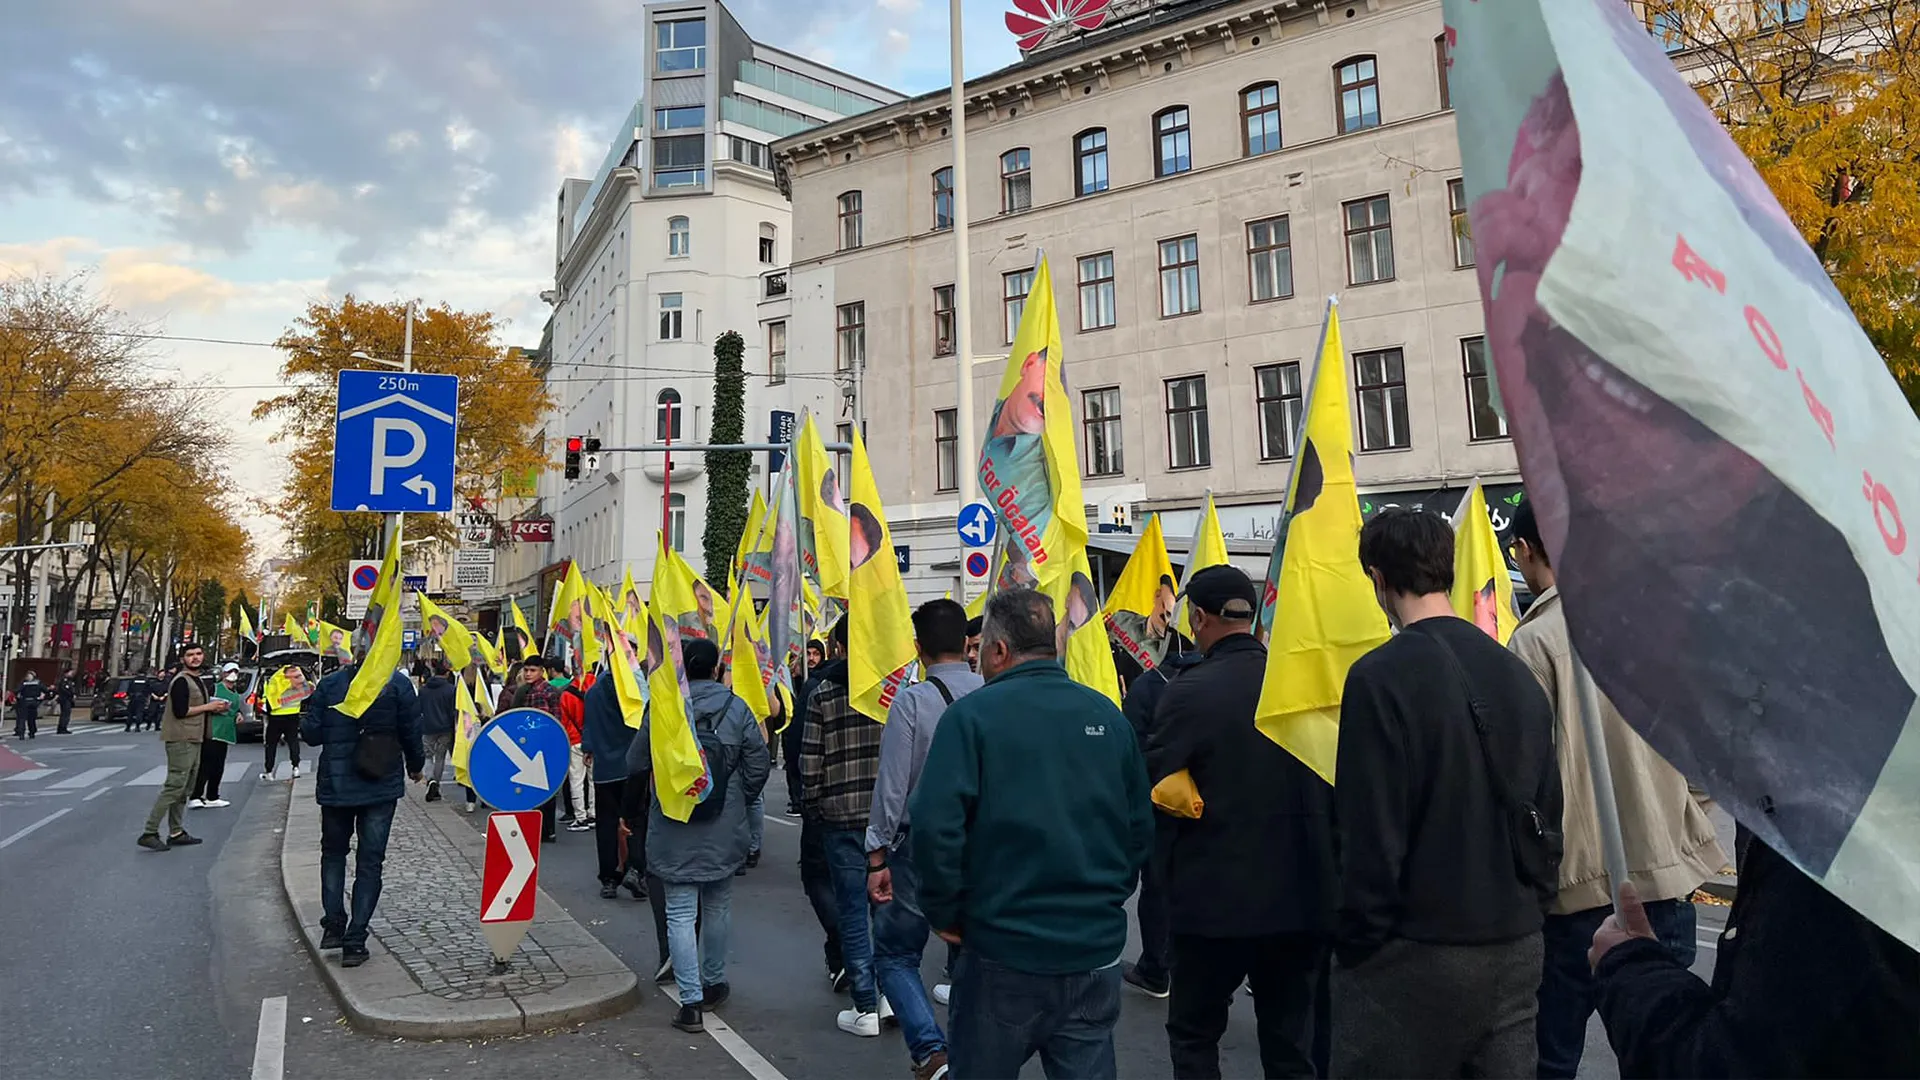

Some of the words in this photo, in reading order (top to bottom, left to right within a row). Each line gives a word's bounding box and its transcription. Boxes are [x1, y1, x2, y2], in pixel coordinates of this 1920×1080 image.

[378, 376, 419, 391] 250m
[370, 417, 427, 495] P
[980, 455, 1002, 492] For
[997, 485, 1048, 565] Öcalan
[516, 522, 550, 534] KFC
[1138, 650, 1155, 669] Fo
